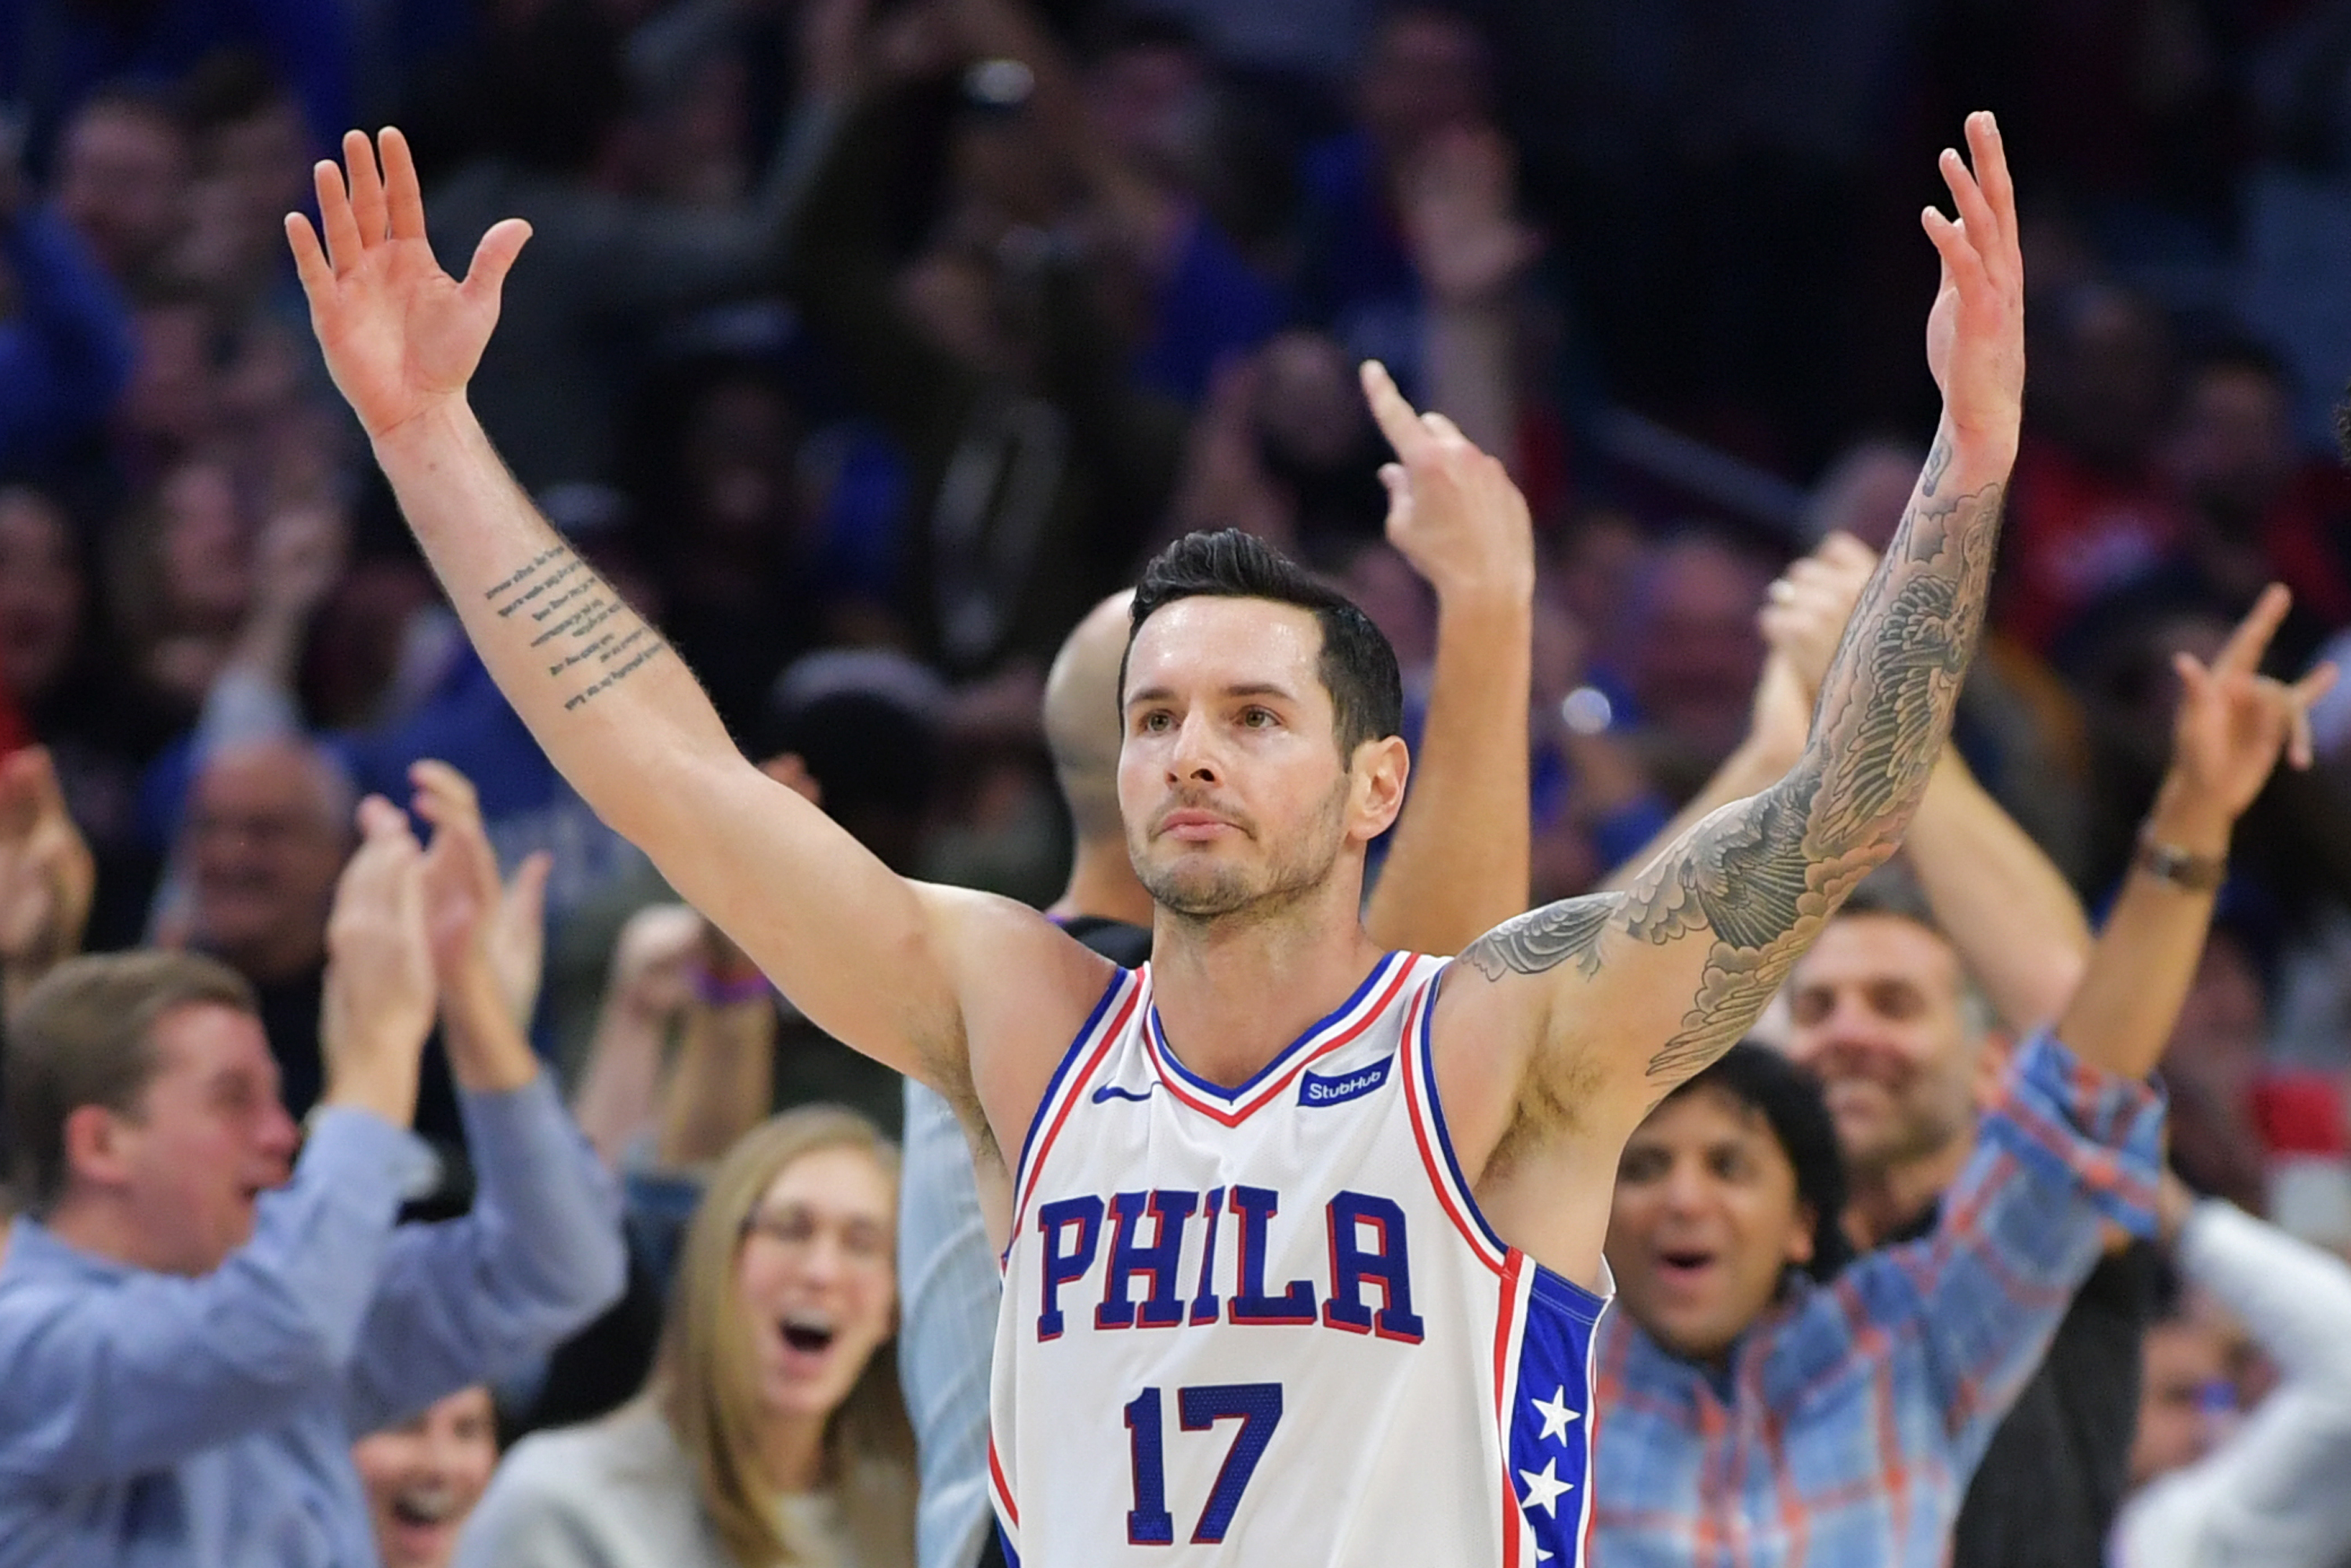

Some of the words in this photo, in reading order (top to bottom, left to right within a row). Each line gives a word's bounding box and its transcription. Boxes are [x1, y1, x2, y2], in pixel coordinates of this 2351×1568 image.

[1309, 1071, 1382, 1099] StubHub
[1037, 1185, 1425, 1345] PHILA
[1124, 1382, 1284, 1546] 17
